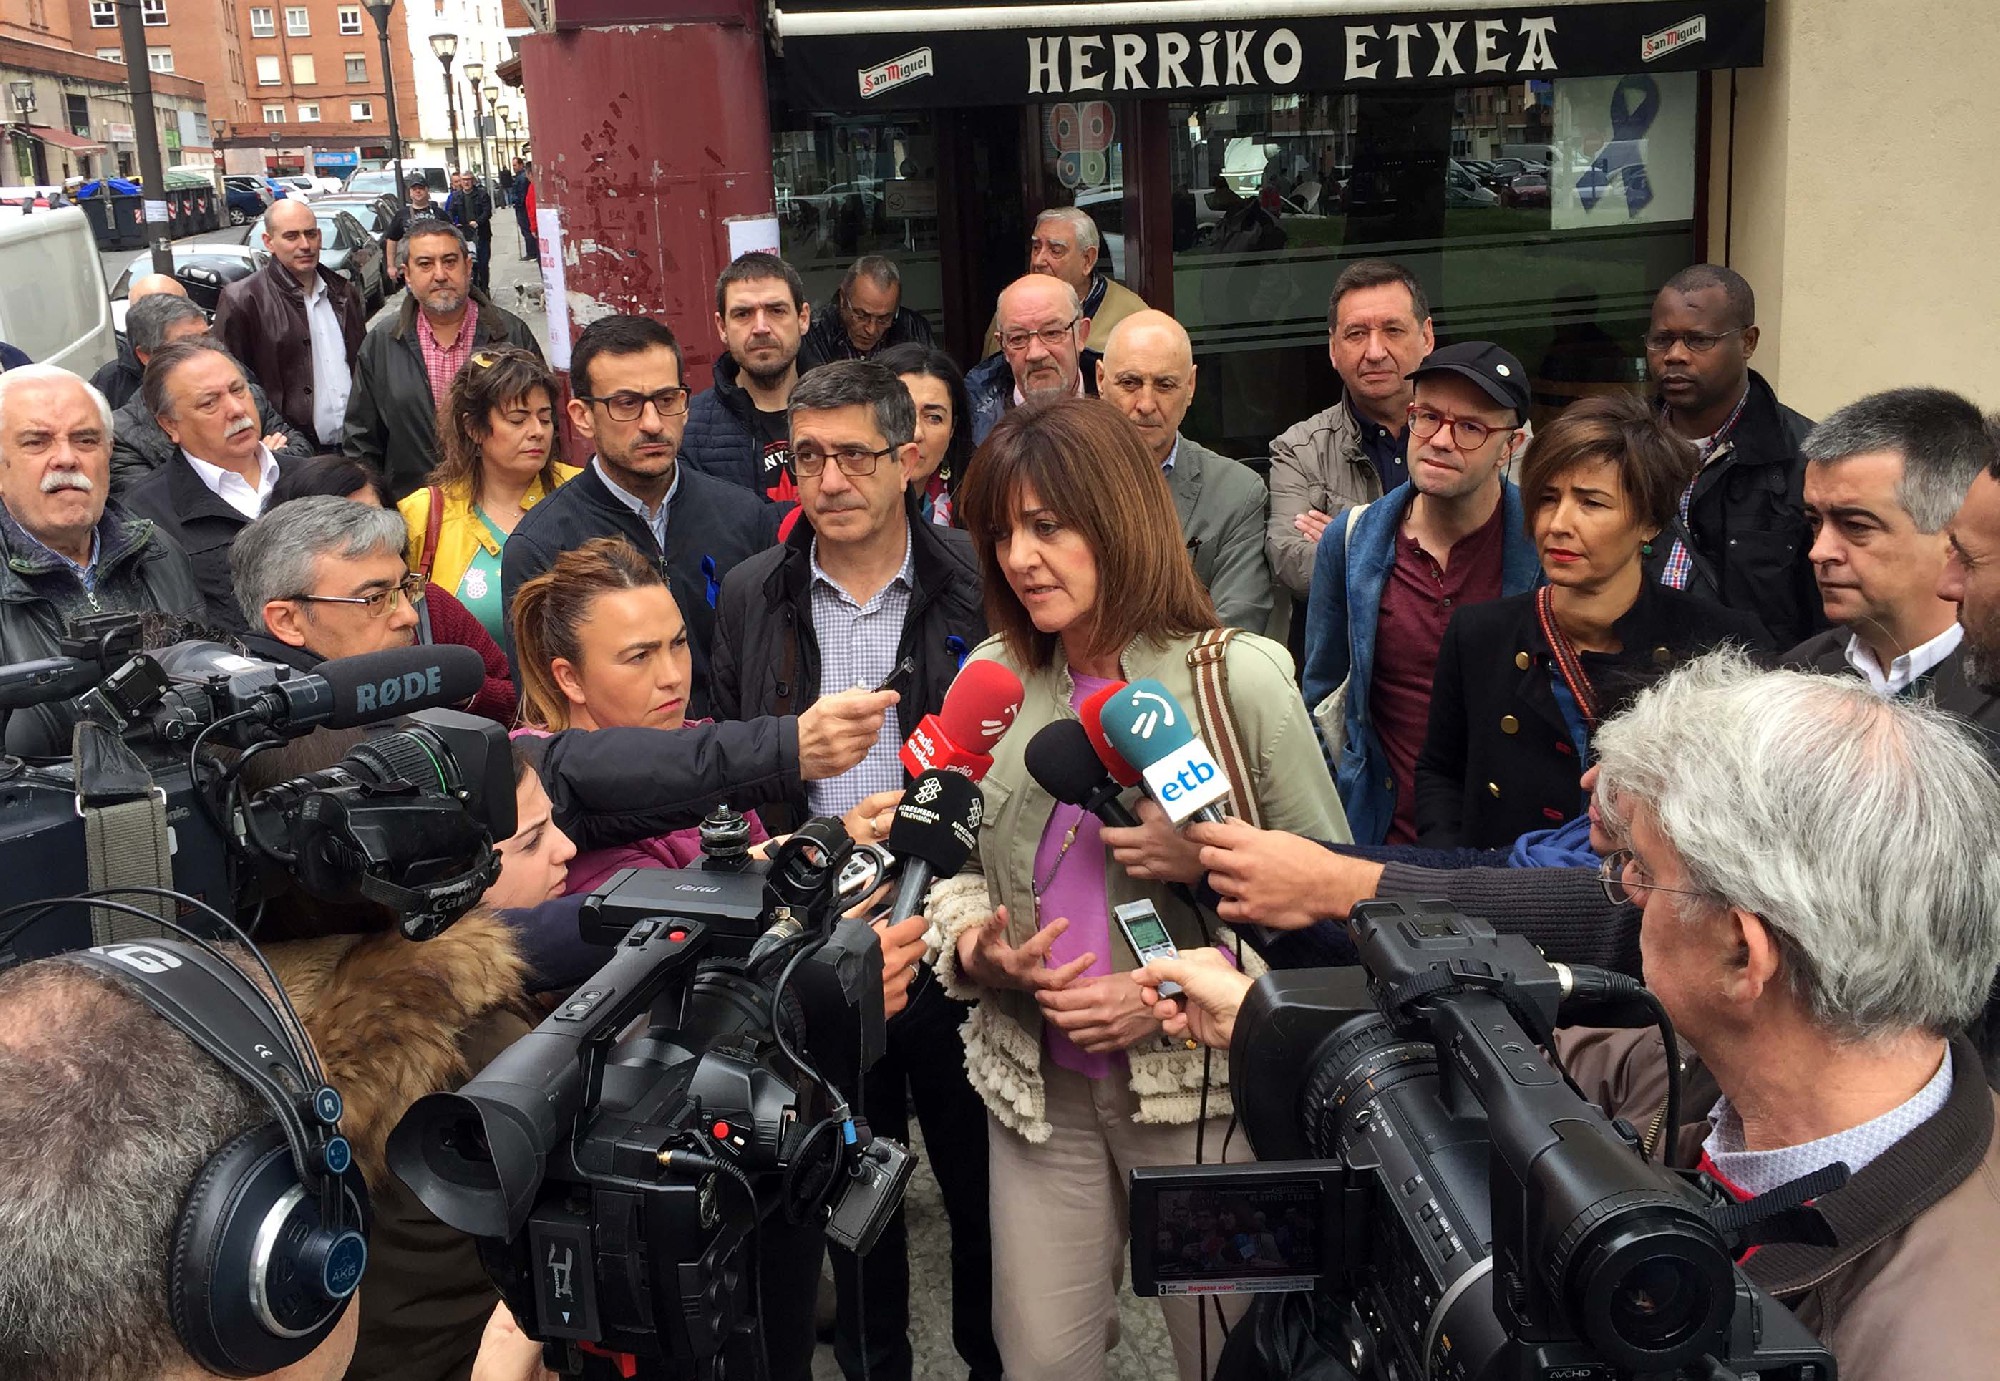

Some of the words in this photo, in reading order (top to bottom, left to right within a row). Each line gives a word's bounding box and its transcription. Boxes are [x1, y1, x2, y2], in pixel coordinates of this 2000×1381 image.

[1665, 21, 1701, 46] Miguel
[1343, 16, 1558, 81] ETXEA
[884, 55, 927, 81] Miguel
[356, 665, 442, 713] RØDE
[914, 728, 935, 757] radio
[1161, 760, 1215, 801] etb
[323, 1098, 335, 1113] R
